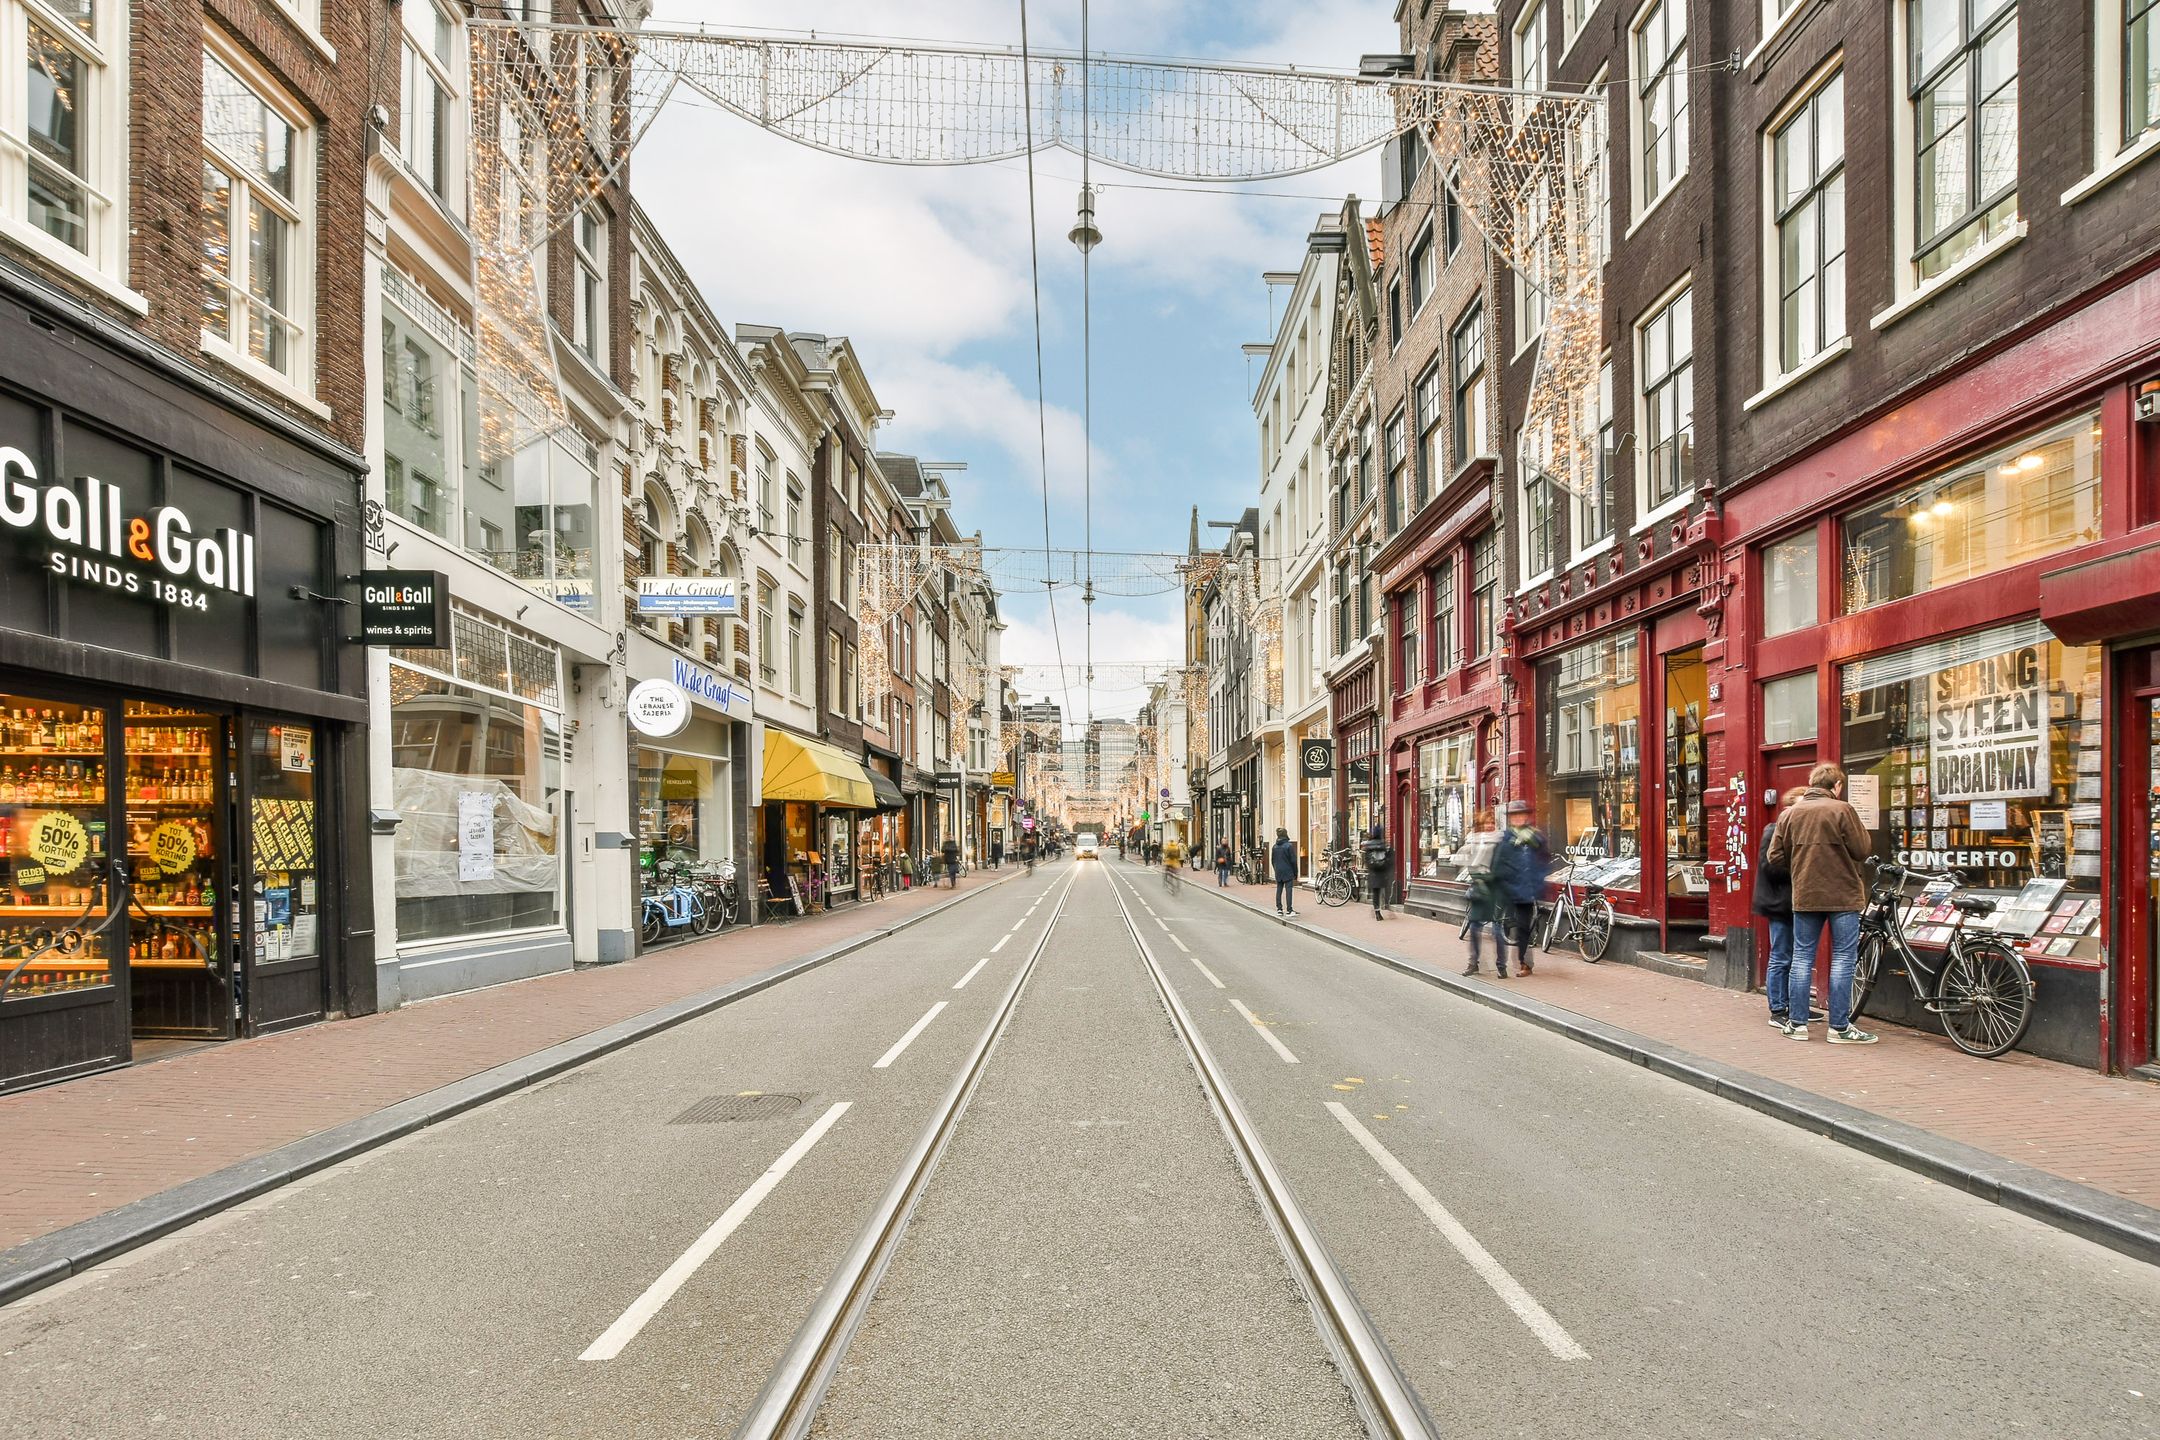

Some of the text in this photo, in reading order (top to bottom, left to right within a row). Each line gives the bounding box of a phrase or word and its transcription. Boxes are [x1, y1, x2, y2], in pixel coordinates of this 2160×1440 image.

[0, 446, 254, 597] Gall&Gall
[51, 552, 208, 612] SINDS 1884
[665, 582, 682, 596] de
[687, 582, 732, 599] Graaf
[365, 586, 432, 604] Gall&Gall
[366, 625, 433, 637] wines & spirits
[1937, 647, 2038, 704] SPRING
[1937, 689, 2039, 742] STEEN
[1978, 739, 1993, 748] ON
[1937, 745, 2040, 796] BROADWAY
[55, 817, 72, 829] TOT
[169, 827, 182, 836] TOT
[40, 825, 79, 850] 50%
[157, 833, 188, 854] 50%
[256, 815, 279, 857] KELDER
[276, 816, 299, 856] KELDER
[38, 843, 77, 860] KORTING
[155, 847, 186, 862] KORTING
[1565, 845, 1605, 856] CONCERTO
[1897, 850, 2017, 868] CONCERTO
[17, 867, 45, 879] KELDER
